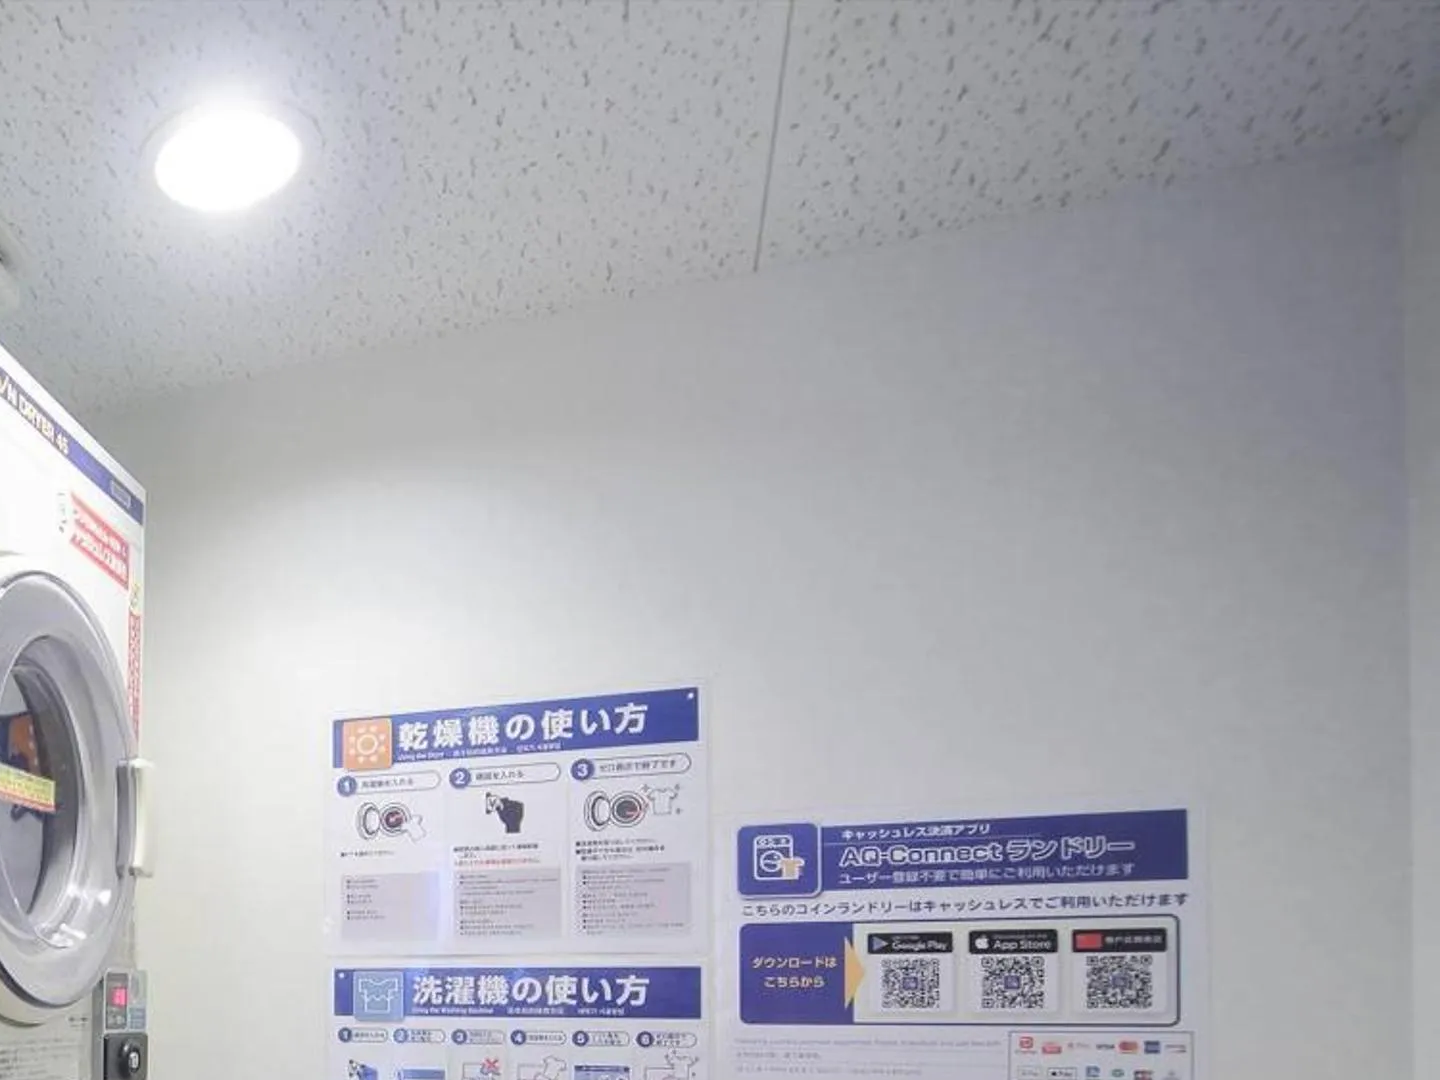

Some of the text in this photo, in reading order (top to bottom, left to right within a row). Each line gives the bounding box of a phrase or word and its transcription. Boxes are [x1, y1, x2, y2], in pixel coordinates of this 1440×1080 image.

[398, 702, 648, 751] 乾燥機の使い方
[839, 835, 1136, 868] AQ-Connect ランドリー
[742, 892, 1189, 917] こちらのコインランドリーはキャッシュレスでご利用いただけます
[993, 938, 1051, 952] App Store
[752, 956, 838, 969] ダウンロードは
[413, 974, 650, 1006] 洗濯機の使い方
